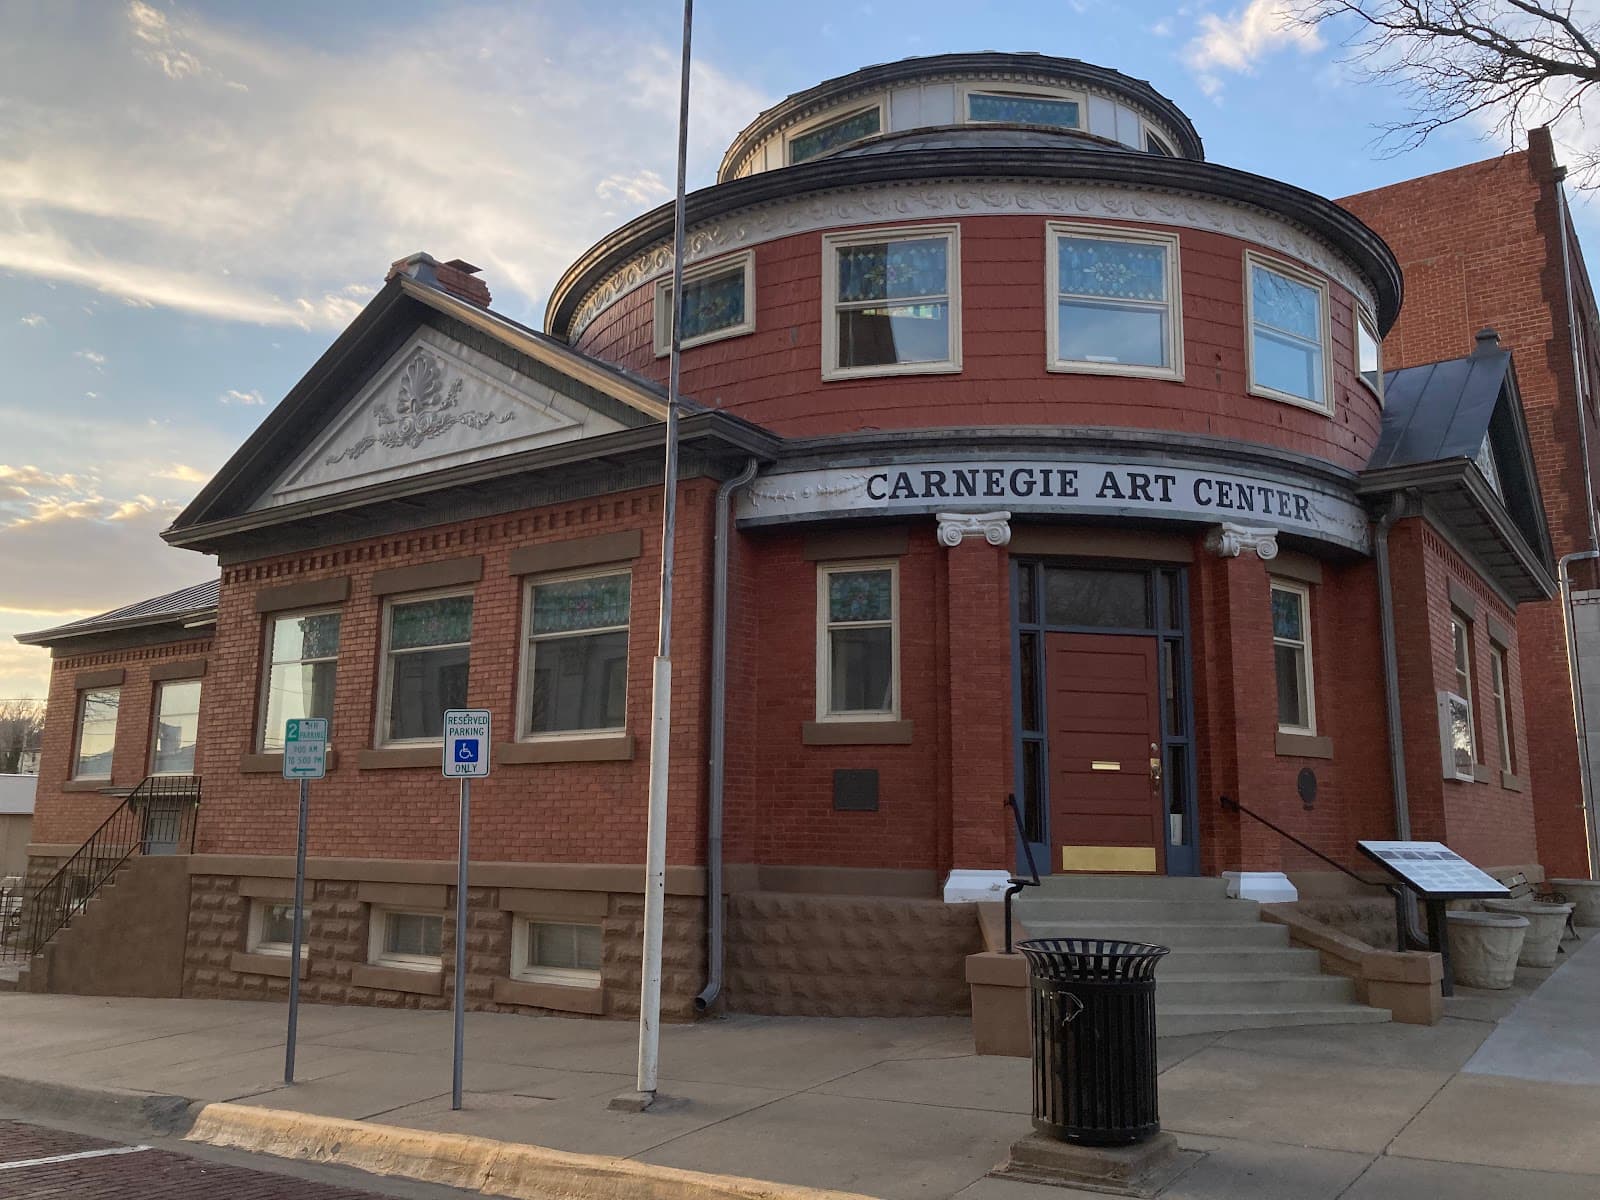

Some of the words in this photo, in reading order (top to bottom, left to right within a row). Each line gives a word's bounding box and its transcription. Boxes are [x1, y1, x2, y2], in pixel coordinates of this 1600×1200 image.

[867, 468, 1079, 500] CARNEGIE
[1095, 471, 1176, 502] ART
[1193, 478, 1312, 522] CENTER
[448, 716, 487, 725] RESERVED
[288, 723, 297, 738] 2
[449, 728, 484, 736] PARKING
[455, 764, 478, 773] ONLY
